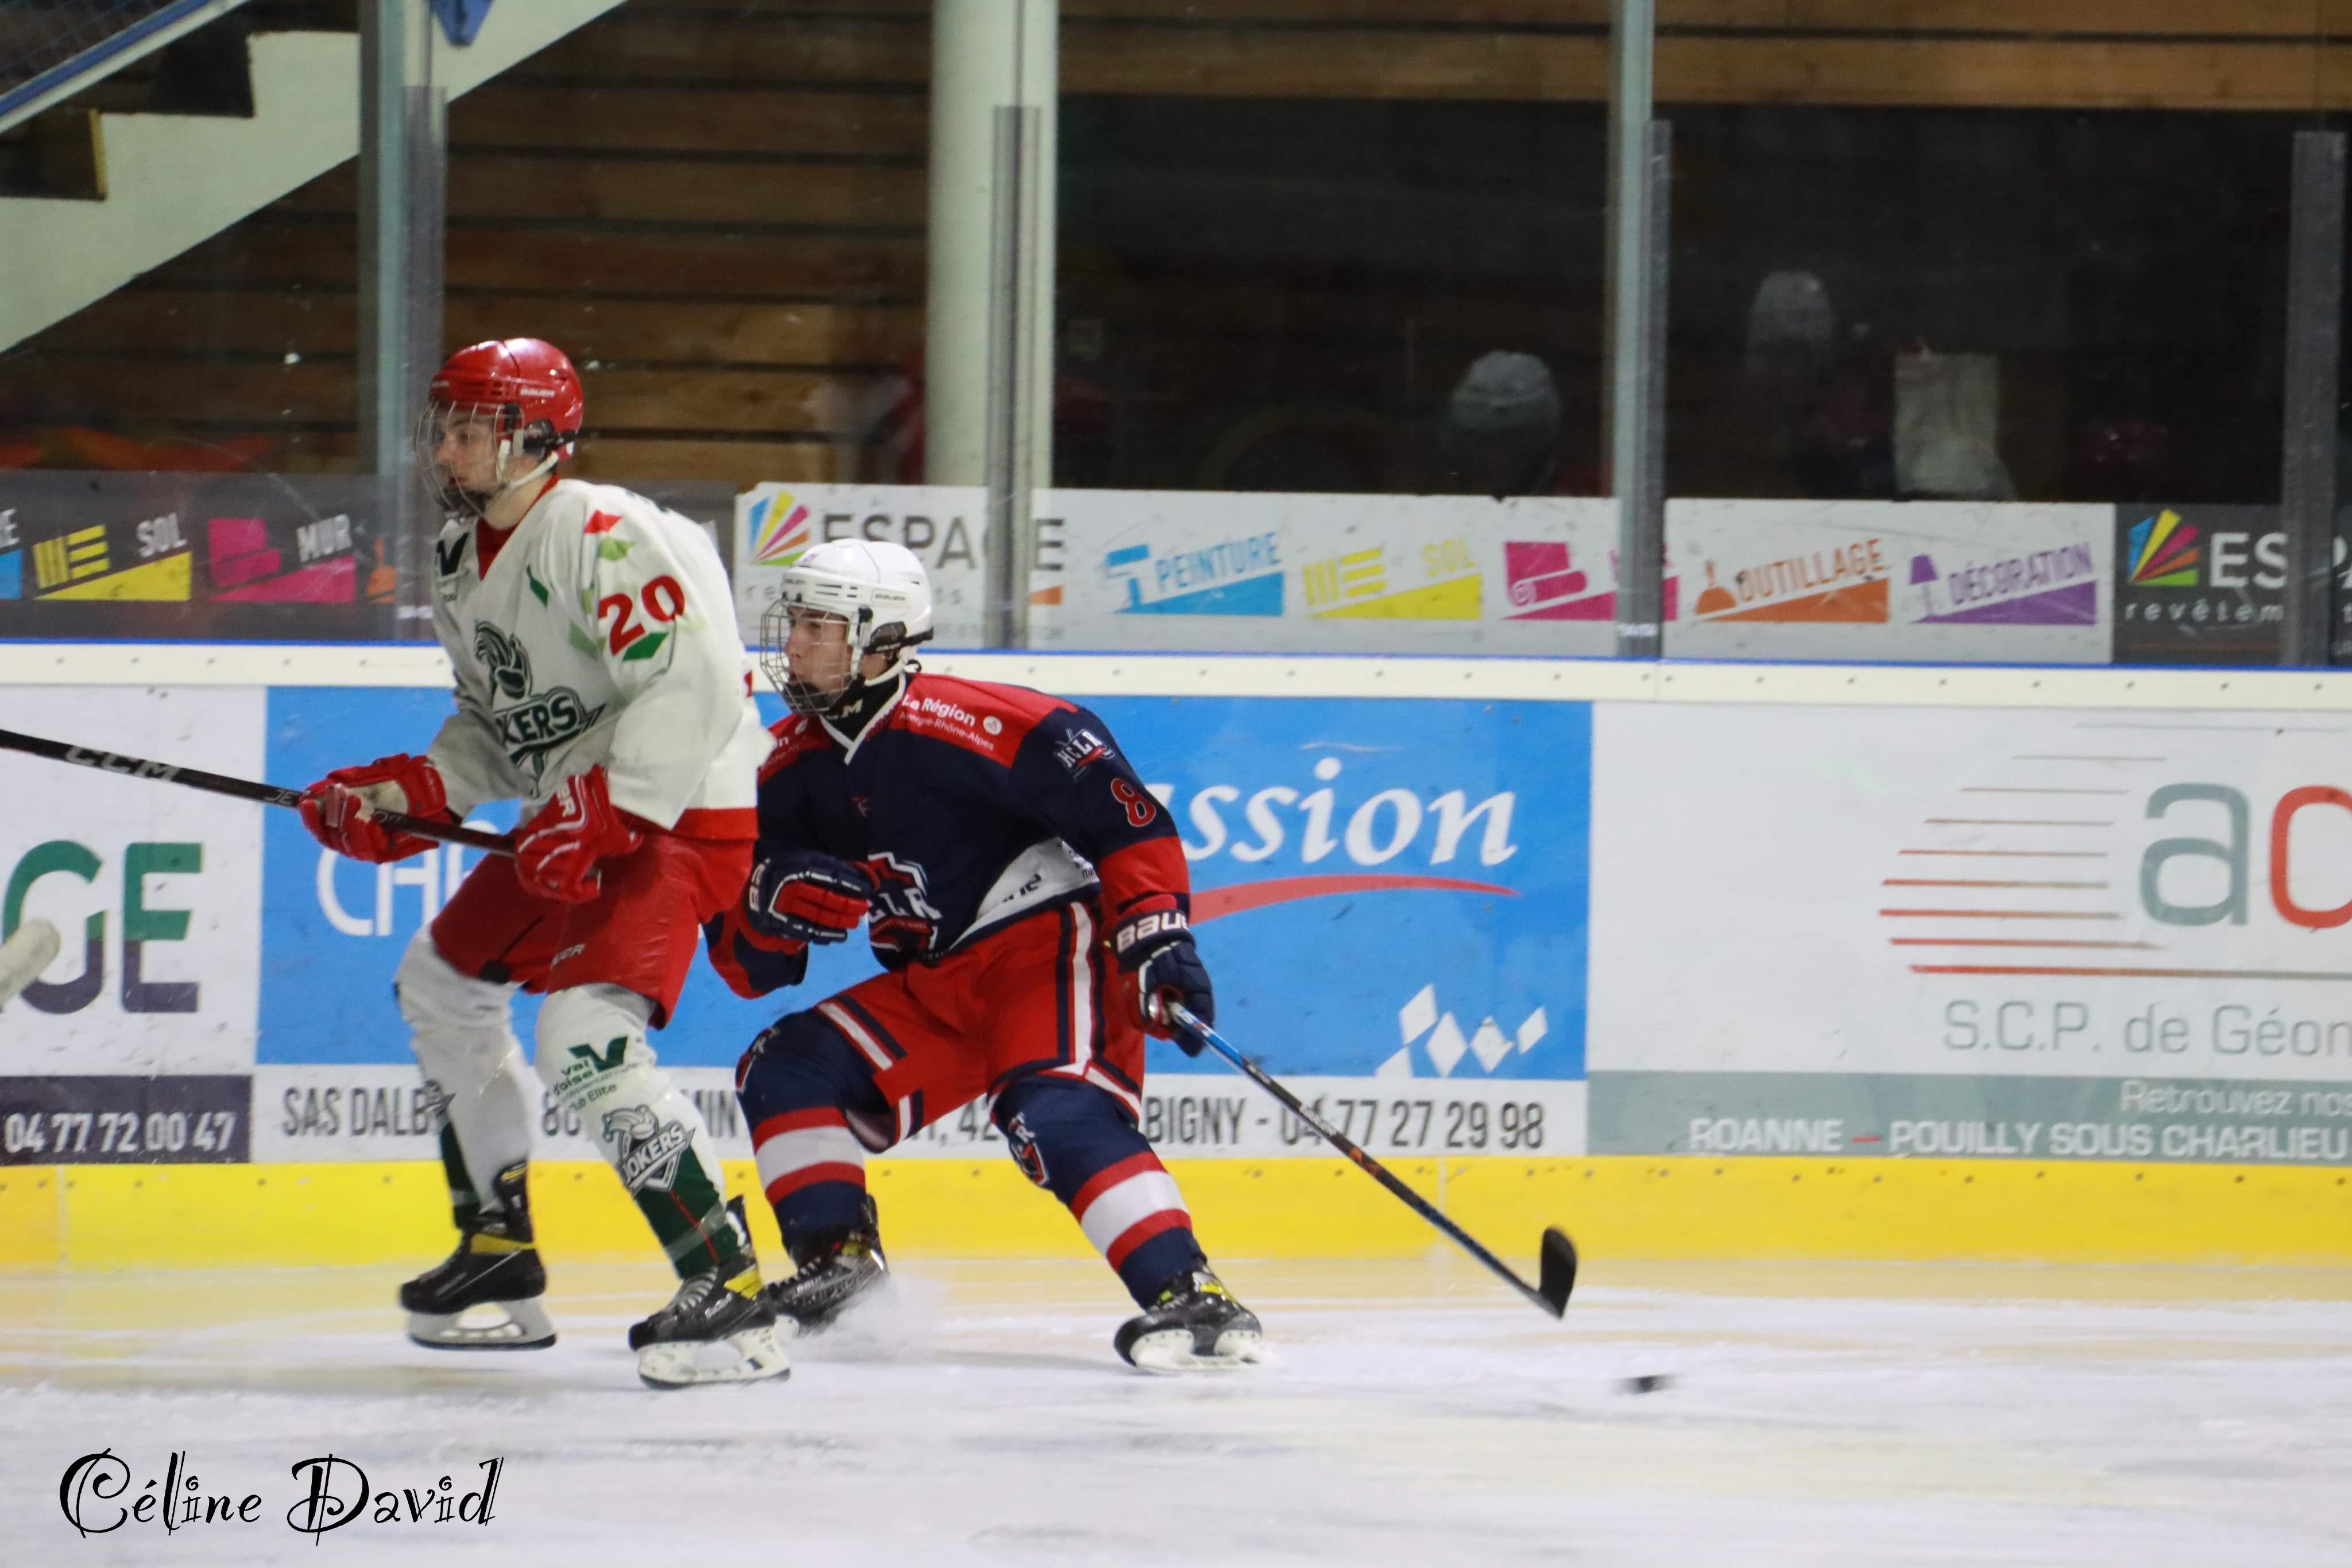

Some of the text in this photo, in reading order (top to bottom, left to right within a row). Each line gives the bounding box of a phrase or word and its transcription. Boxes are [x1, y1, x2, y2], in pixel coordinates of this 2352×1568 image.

[136, 513, 187, 558] SOL
[296, 514, 351, 563] MUR
[1422, 537, 1476, 578] SOL
[1155, 531, 1282, 594] PEINTURE
[1736, 537, 1890, 603] OUTILLAGE
[1948, 541, 2095, 605] DÉCORATION
[597, 575, 685, 656] 20
[902, 694, 976, 727] La Région
[65, 746, 179, 782] CCM
[1111, 778, 1156, 827] 8
[1146, 756, 1519, 866] ssion
[1943, 999, 2101, 1052] S.C.P.
[2123, 1002, 2189, 1054] de
[282, 1087, 342, 1136] SAS
[1337, 1099, 1379, 1147] 77
[1390, 1100, 1437, 1148] 27
[1445, 1101, 1490, 1148] 29
[1500, 1102, 1547, 1149] 98
[587, 1083, 617, 1104] Elite
[2121, 1079, 2294, 1116] Retrouvez
[4, 1112, 237, 1153] 04 77 72 00 47
[1689, 1117, 1844, 1151] ROANNE
[1889, 1120, 2044, 1155] POUILLY
[2048, 1122, 2154, 1157] SOUS
[2161, 1123, 2350, 1159] CHARLIEU
